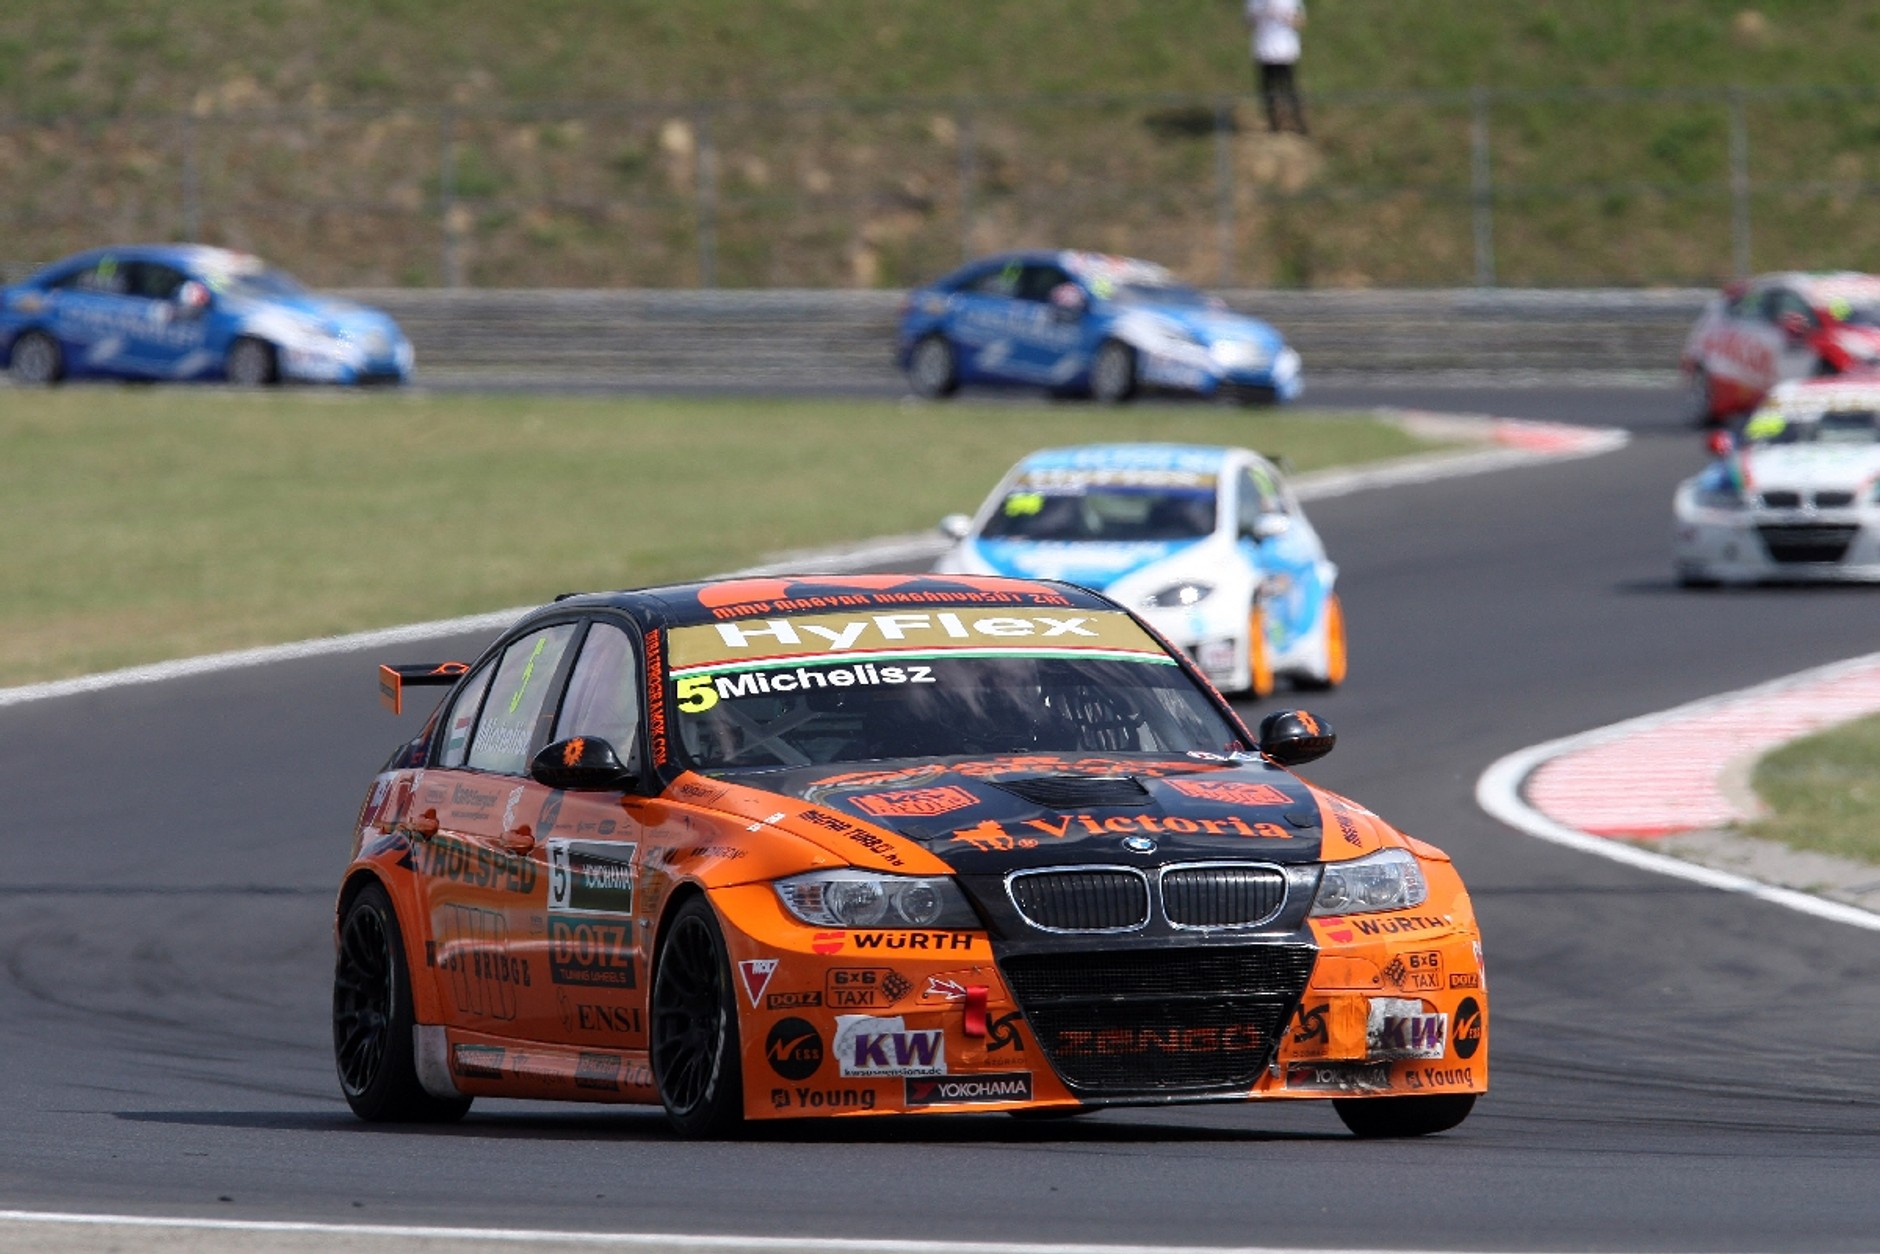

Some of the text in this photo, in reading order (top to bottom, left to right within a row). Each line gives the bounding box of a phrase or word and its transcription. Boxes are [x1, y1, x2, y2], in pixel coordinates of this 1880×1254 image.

[715, 612, 1099, 650] HyFlex
[676, 664, 937, 714] 5 Michelisz
[1020, 814, 1294, 839] Victoria
[552, 846, 567, 903] 5
[1352, 916, 1447, 936] WÜRTH
[554, 922, 627, 968] DOTZ
[853, 932, 973, 951] WÜRTH
[473, 948, 531, 988] BRIDGE
[1411, 972, 1440, 988] TAXI
[835, 990, 875, 1006] TAXI
[576, 1003, 641, 1033] ENSI
[1380, 1015, 1445, 1049] KW
[854, 1031, 943, 1068] KW
[937, 1080, 1028, 1099] YOKOHAMA
[1426, 1067, 1474, 1088] Young
[795, 1087, 876, 1110] Young
